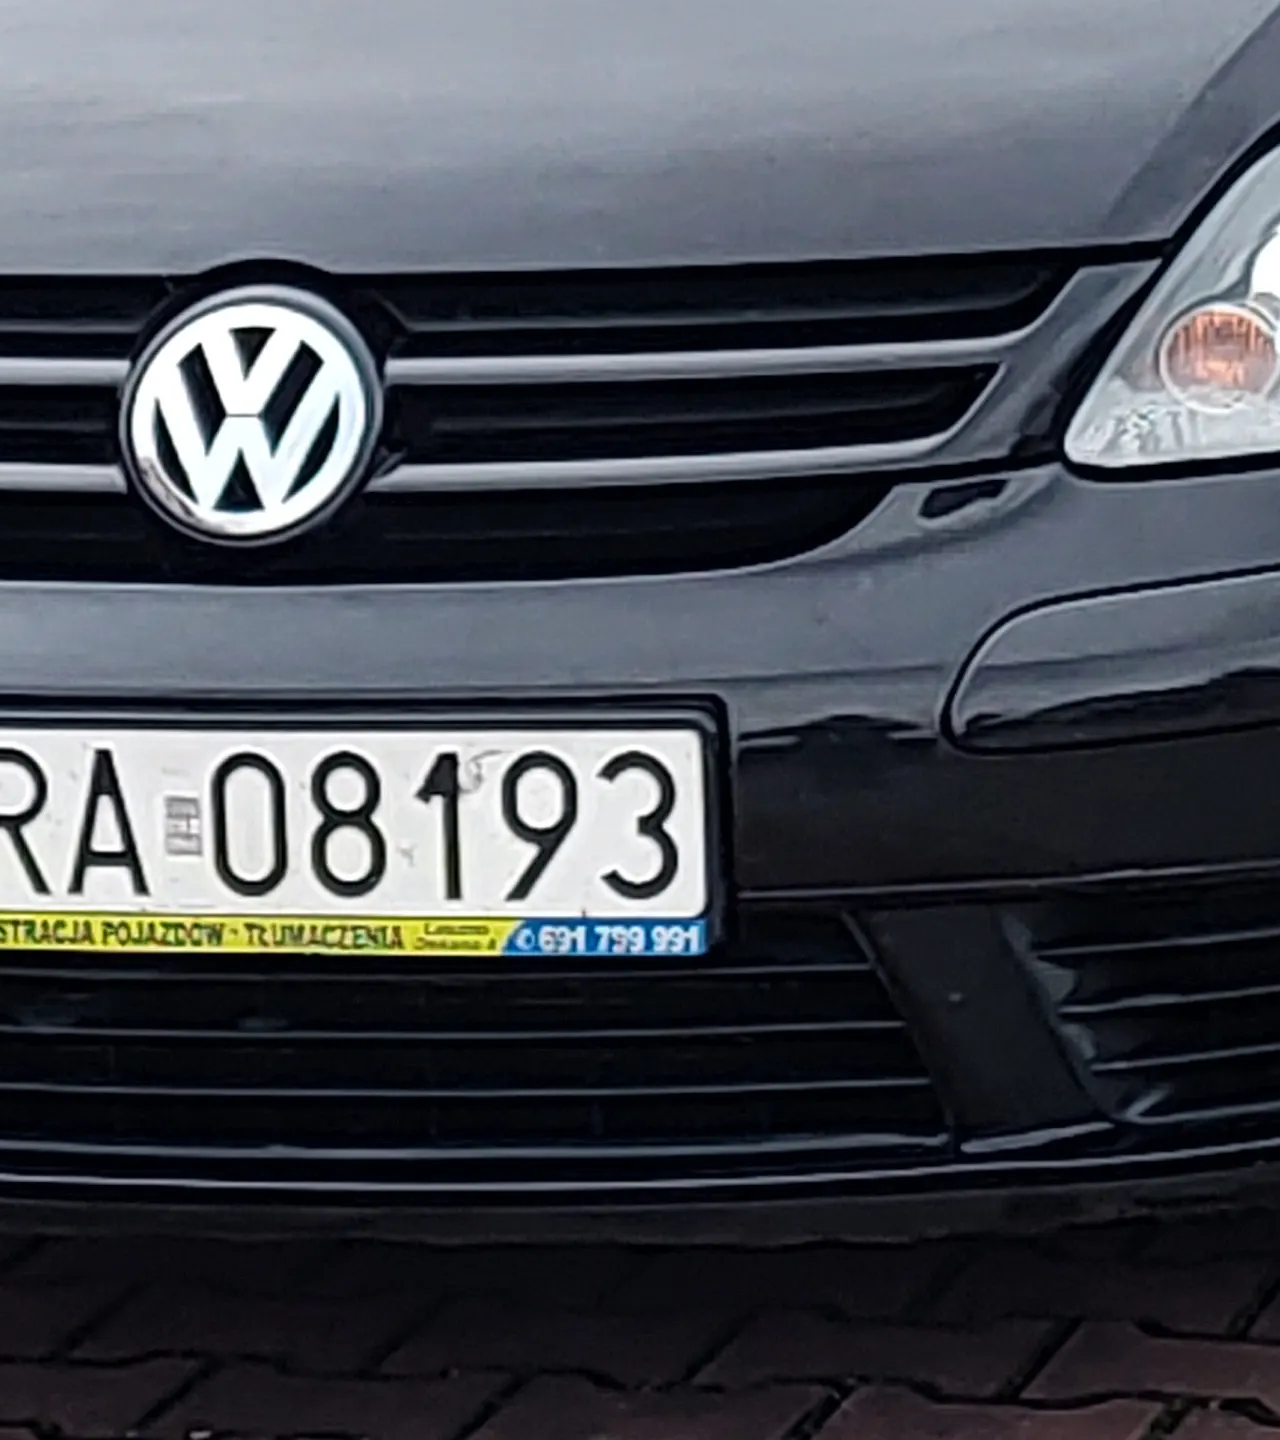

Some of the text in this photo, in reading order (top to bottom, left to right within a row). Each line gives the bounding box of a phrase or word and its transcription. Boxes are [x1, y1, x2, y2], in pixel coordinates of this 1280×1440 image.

[210, 750, 680, 902] 08193
[538, 925, 701, 954] 691 799 991
